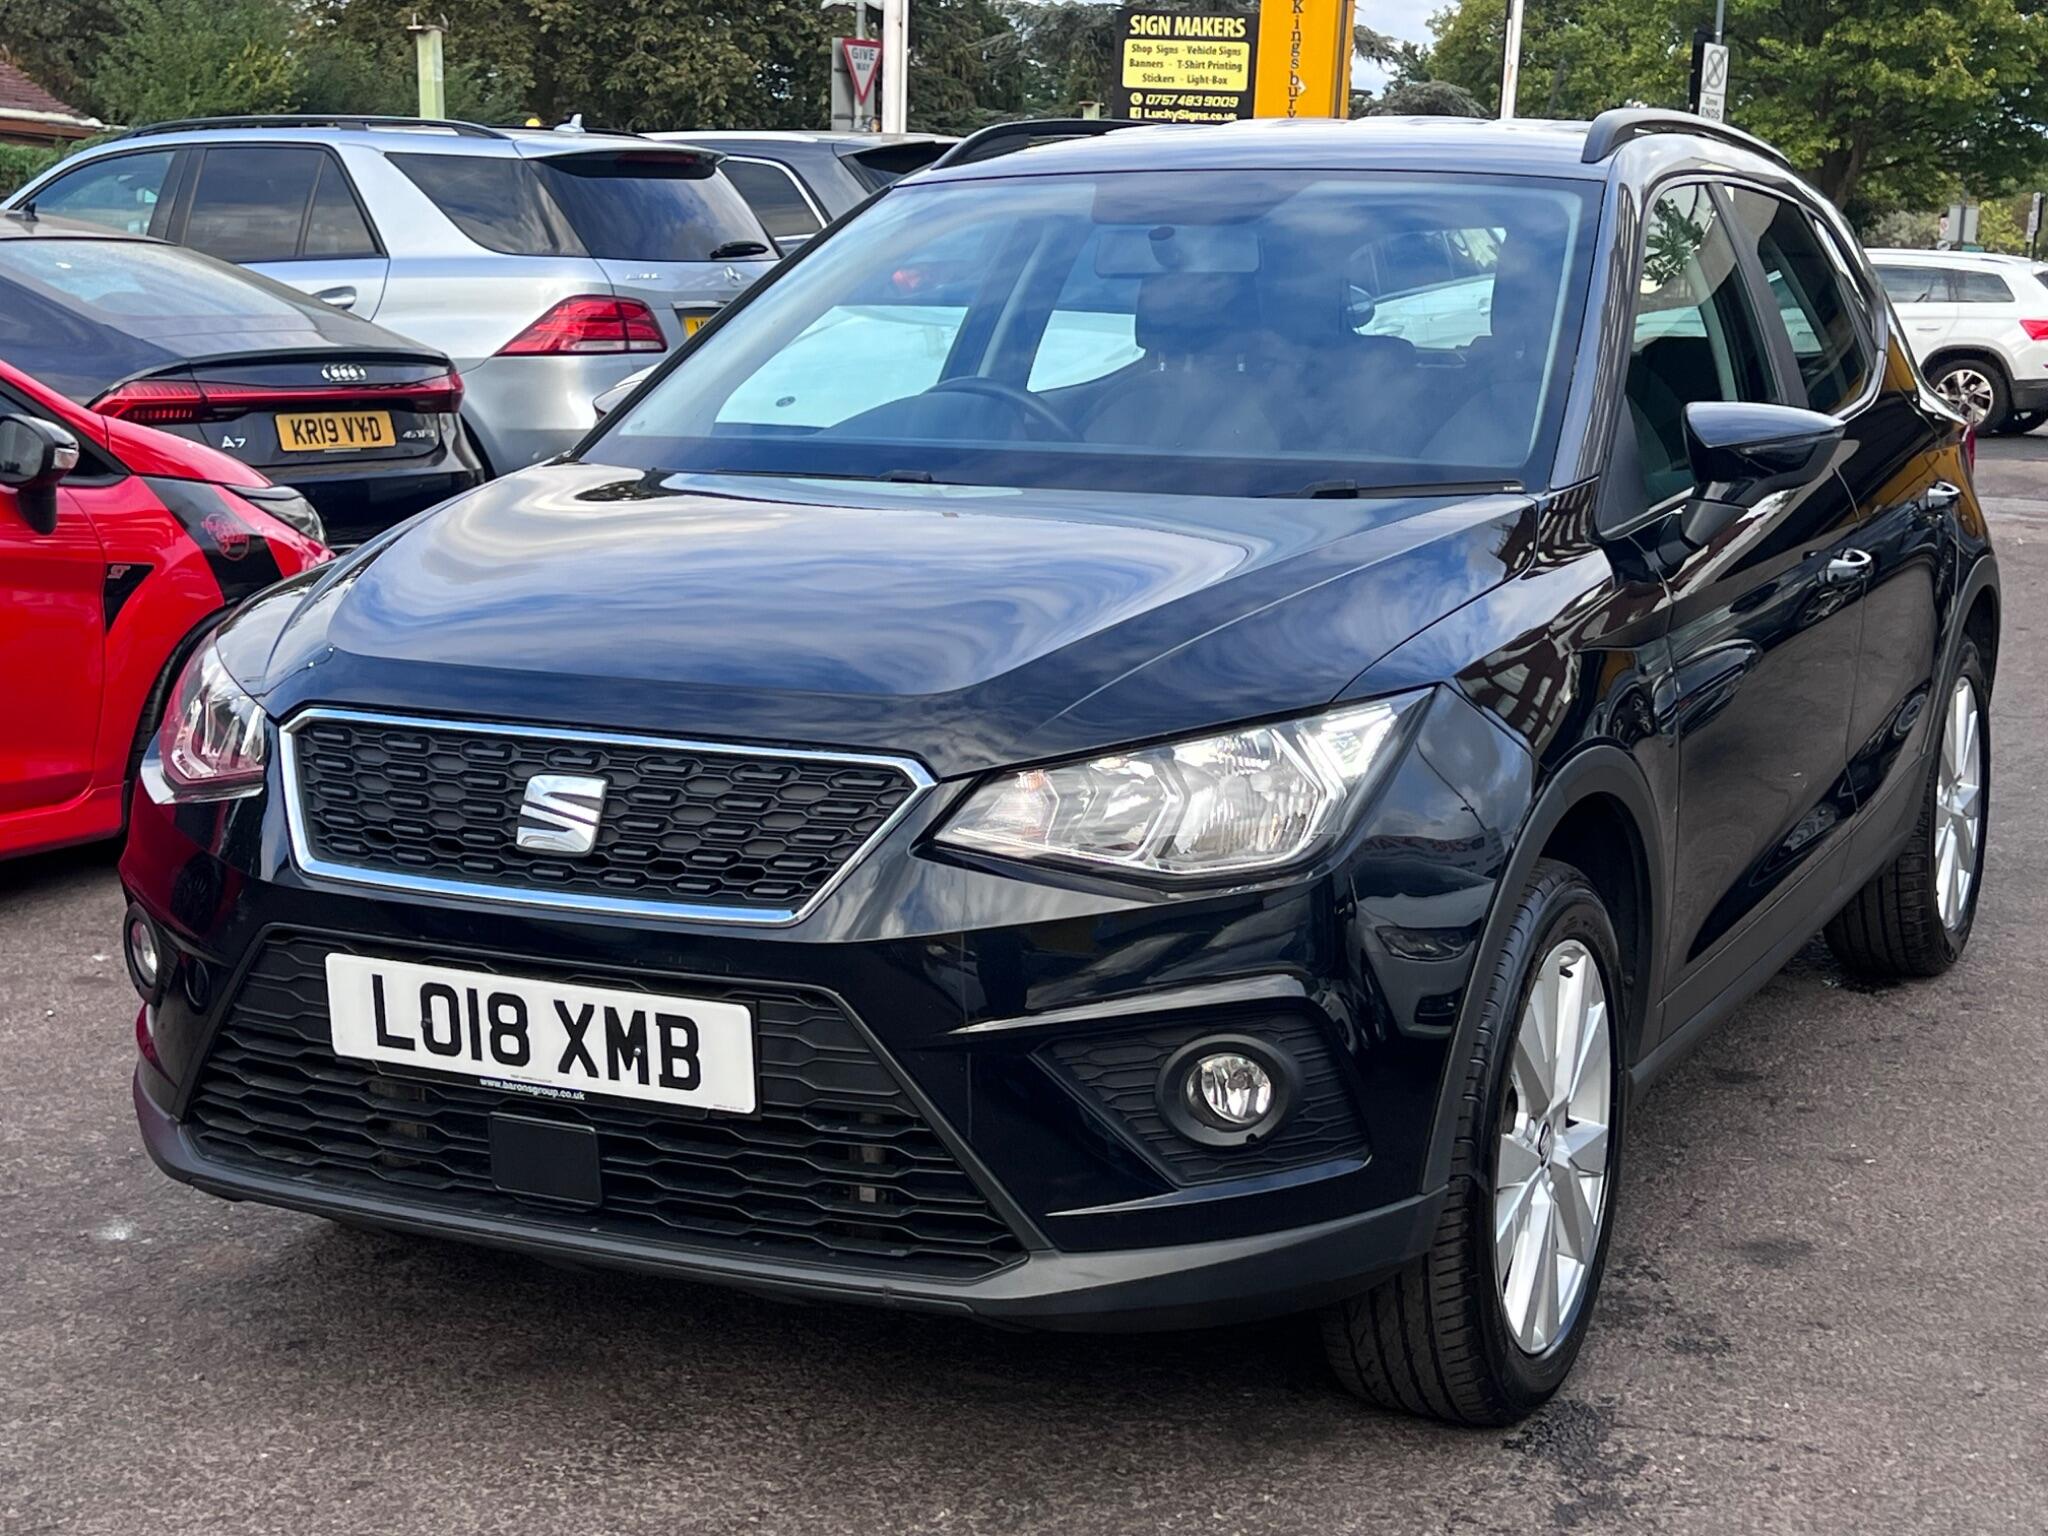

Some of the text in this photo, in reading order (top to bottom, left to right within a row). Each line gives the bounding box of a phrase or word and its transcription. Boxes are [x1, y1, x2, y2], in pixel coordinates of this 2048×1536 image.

[1129, 15, 1246, 38] SIGN MAKERS
[851, 47, 875, 60] GIVE
[1131, 44, 1241, 58] Shop Signs Vehicle Signs
[1129, 59, 1243, 73] Banners T-Shirt Printing
[1142, 73, 1175, 83] Stickers
[1145, 94, 1178, 106] 0757
[1203, 96, 1239, 108] 9009
[1144, 108, 1238, 122] LuckySigns.co.uk
[290, 416, 382, 445] KR19 VYD
[221, 435, 246, 449] A7
[371, 973, 701, 1091] LO18 XMB
[480, 1078, 585, 1100] www.baronsgroup.co.uk
